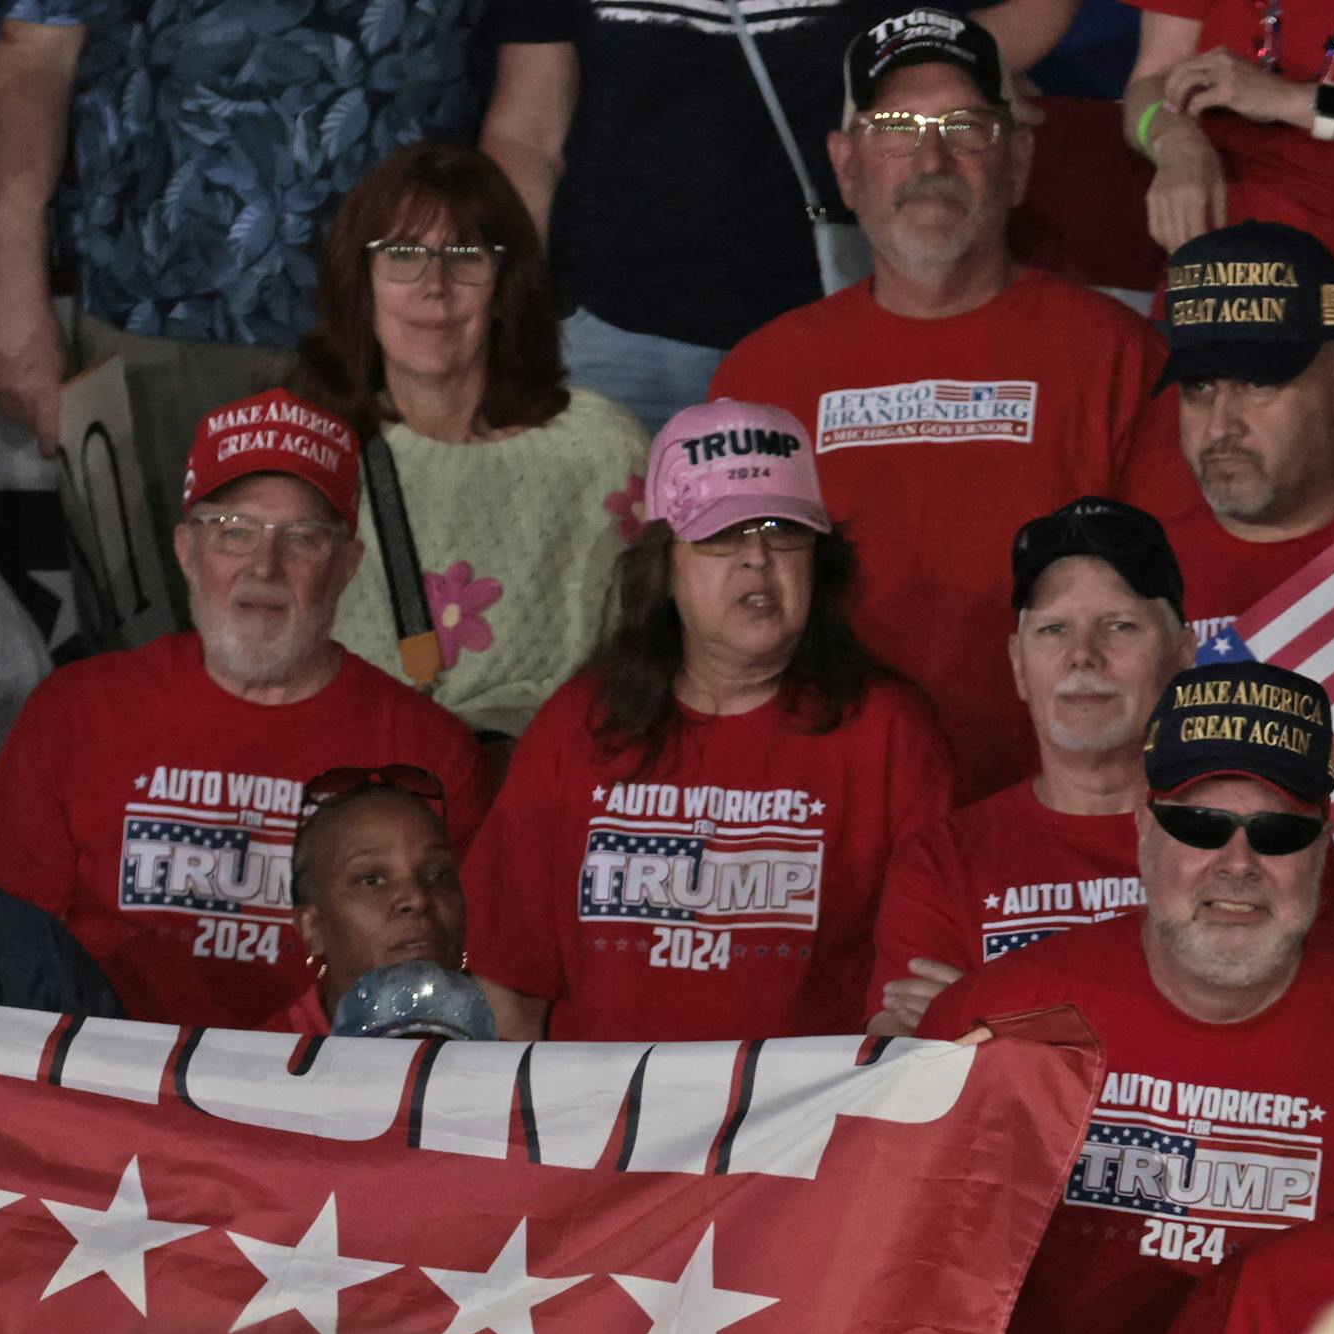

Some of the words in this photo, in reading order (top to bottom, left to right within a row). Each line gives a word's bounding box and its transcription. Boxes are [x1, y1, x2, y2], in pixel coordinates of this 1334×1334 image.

[1202, 261, 1299, 287] AMERICA
[1218, 296, 1286, 323] AGAIN
[823, 402, 1029, 429] BRANDENBURG
[825, 390, 891, 411] LET'S
[896, 385, 931, 403] GO
[207, 404, 264, 437] MAKE
[265, 401, 352, 451] AMERICA
[833, 424, 916, 441] MICHIGAN
[919, 421, 1013, 435] GOVERNOR
[218, 430, 279, 463] GREAT
[280, 432, 341, 473] AGAIN
[683, 428, 800, 465] TRUMP
[727, 467, 771, 480] 2024
[1173, 680, 1231, 710] MAKE
[1232, 680, 1323, 726] AMERICA
[1180, 715, 1247, 743] GREAT
[1248, 718, 1313, 757] AGAIN
[148, 766, 222, 806] AUTO
[606, 783, 679, 816] AUTO
[683, 785, 809, 823] WORKERS
[238, 810, 264, 827] FOR
[585, 851, 815, 911] TRUMP
[1002, 883, 1073, 916] AUTO
[192, 917, 281, 965] 2024
[649, 926, 731, 971] 2024
[1100, 1071, 1173, 1112] AUTO
[1176, 1082, 1310, 1129] WORKERS
[1186, 1119, 1212, 1136] FOR
[1078, 1142, 1314, 1213] TRUMP
[1138, 1218, 1227, 1265] 2024
